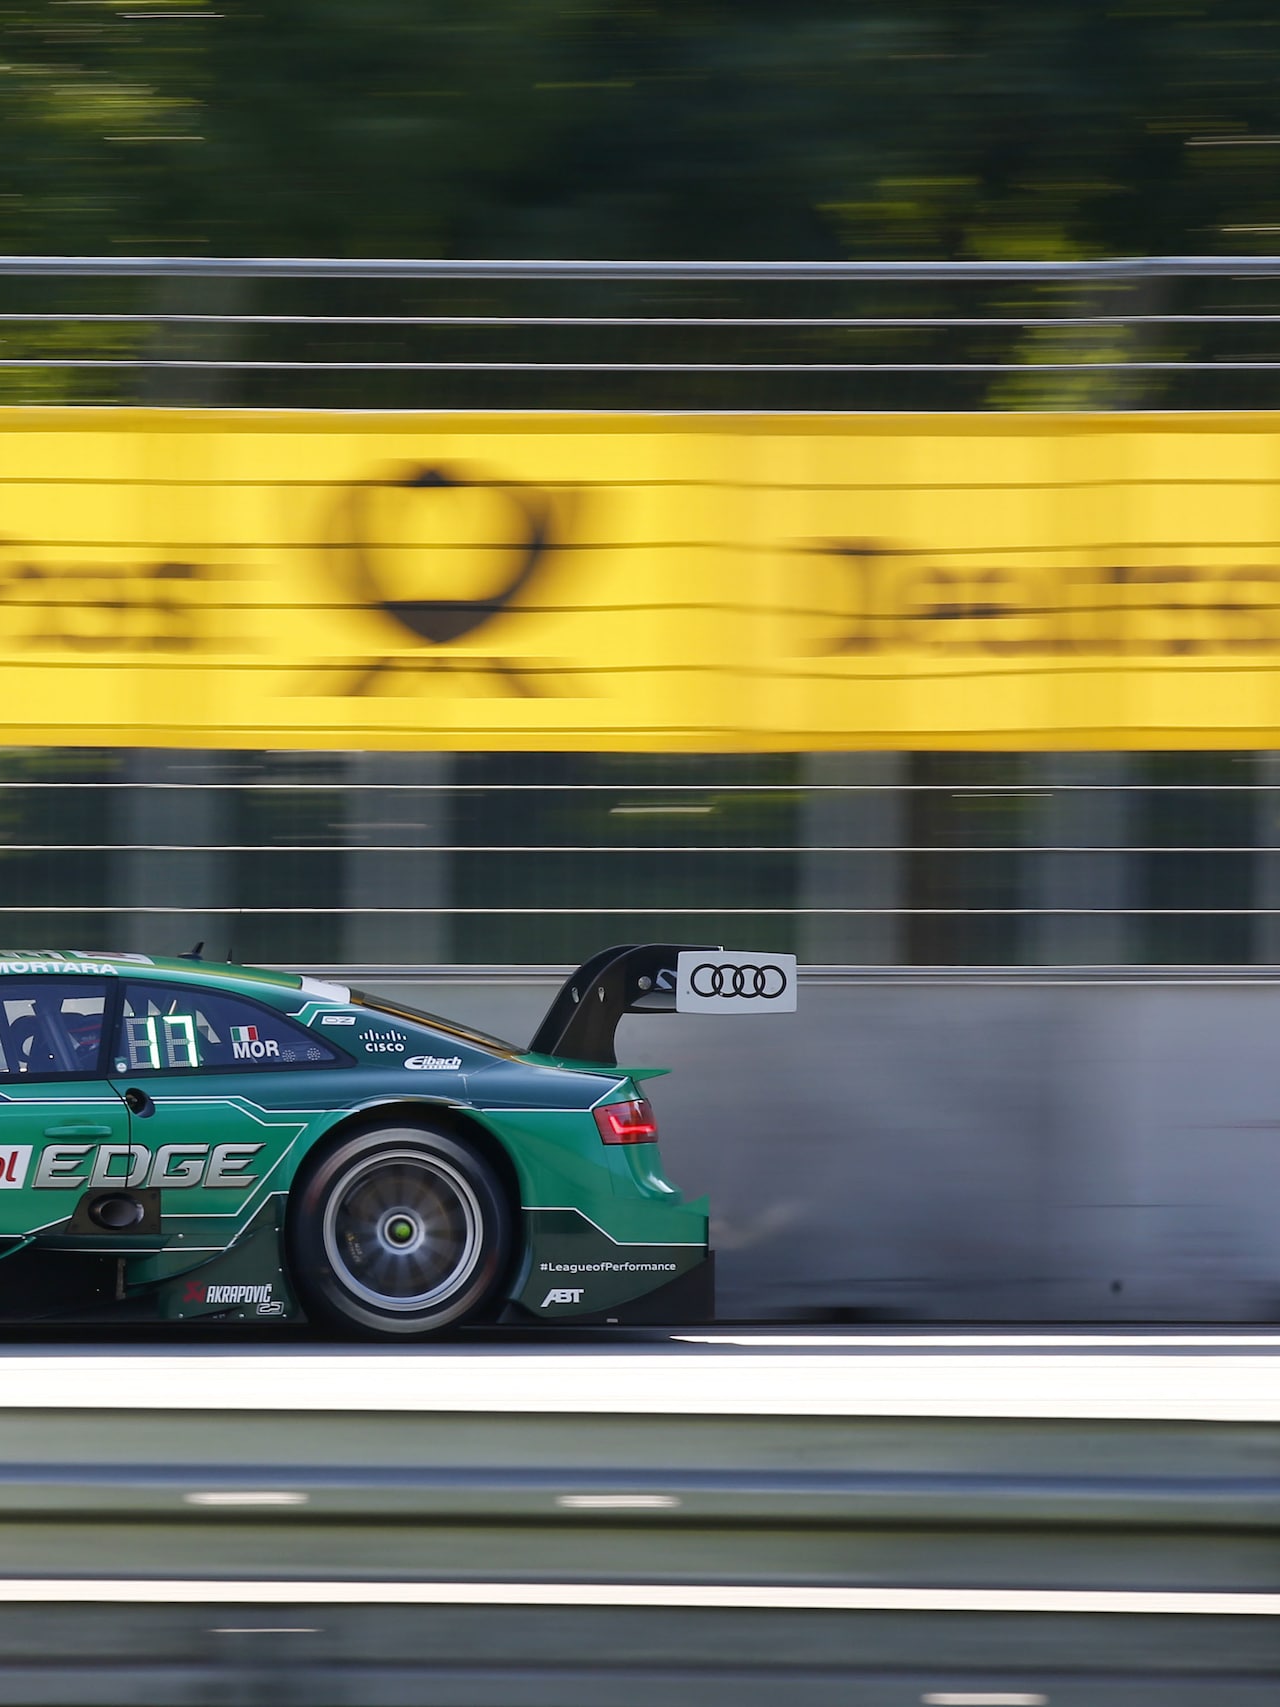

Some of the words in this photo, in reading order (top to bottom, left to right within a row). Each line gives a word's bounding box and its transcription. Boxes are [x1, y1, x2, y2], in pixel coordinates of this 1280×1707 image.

[146, 1015, 199, 1069] 17
[232, 1040, 280, 1059] MOR
[404, 1055, 462, 1069] Eibach
[31, 1142, 268, 1189] EDGE
[540, 1262, 677, 1274] #LeagueofPerformance
[540, 1288, 585, 1308] ABT
